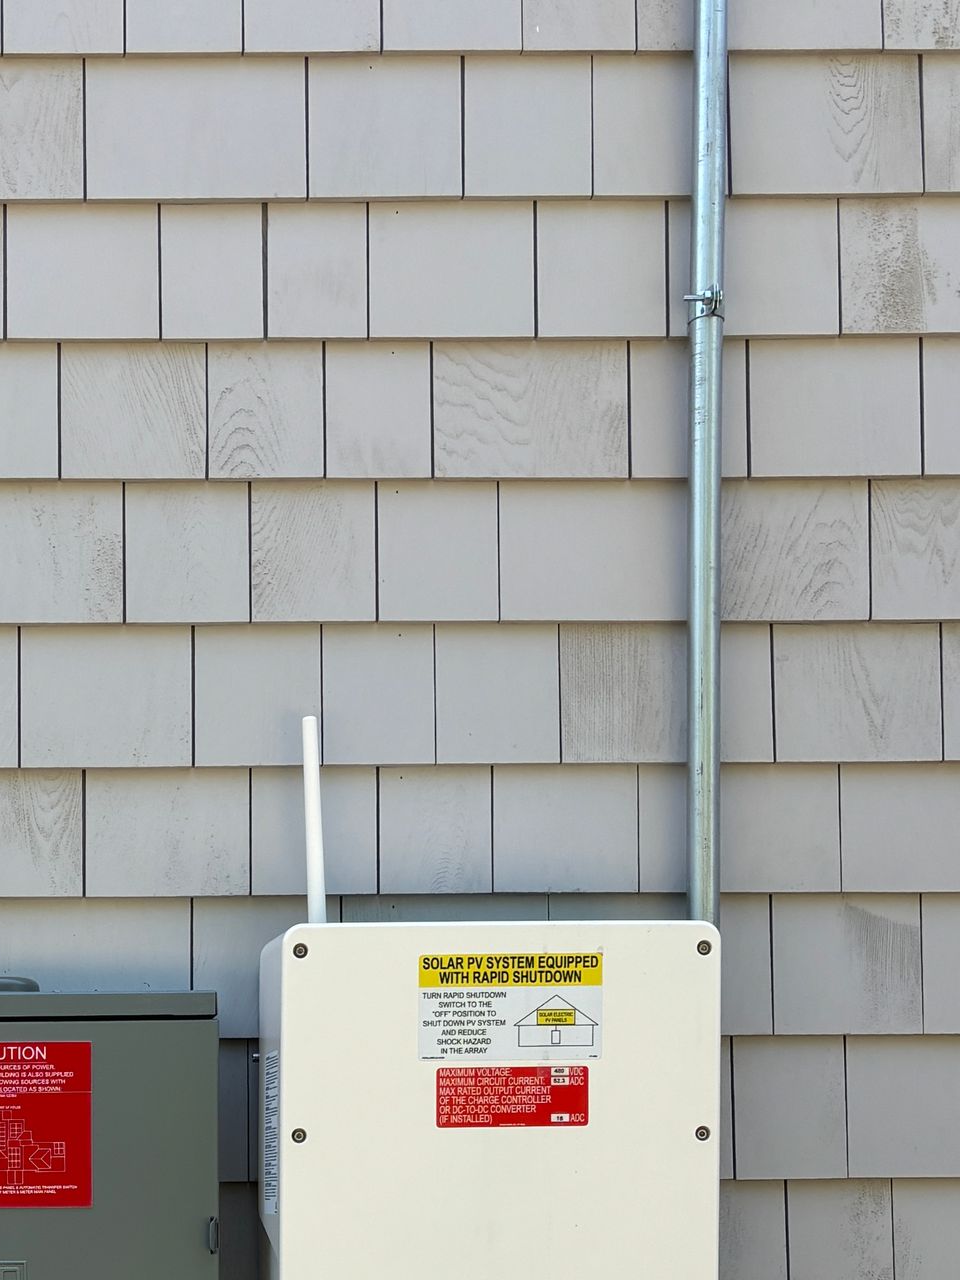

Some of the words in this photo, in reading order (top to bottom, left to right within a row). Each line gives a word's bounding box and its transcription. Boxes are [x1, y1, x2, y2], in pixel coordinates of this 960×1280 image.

[422, 957, 463, 970] SOLAR
[466, 957, 483, 970] PV
[485, 956, 534, 970] SYSTEM
[537, 956, 598, 969] EQUIPPED
[439, 971, 469, 984] WITH
[472, 971, 509, 984] RAPID
[512, 970, 582, 983] SHUTDOWN
[466, 991, 507, 999] SHUTDOWN
[440, 1068, 475, 1077] MAXIMUM
[569, 1067, 584, 1076] VDC
[440, 1078, 475, 1086] MAXIMUM
[476, 1077, 506, 1086] CIRCUIT
[570, 1077, 584, 1086] ADC
[440, 1087, 455, 1095] MAX
[457, 1087, 481, 1095] RATED
[483, 1086, 513, 1095] OUTPUT
[515, 1086, 551, 1095] CURRENT
[440, 1096, 450, 1105] OF
[451, 1096, 466, 1104] THE
[467, 1096, 499, 1104] CHARGE
[501, 1095, 551, 1104] CONTROLLER
[440, 1105, 450, 1114] OR
[452, 1105, 488, 1114] DC-TO-DC
[490, 1105, 536, 1114] CONVERTER
[440, 1115, 448, 1124] (IF
[450, 1115, 492, 1124] INSTALLED)
[570, 1114, 585, 1122] ADC
